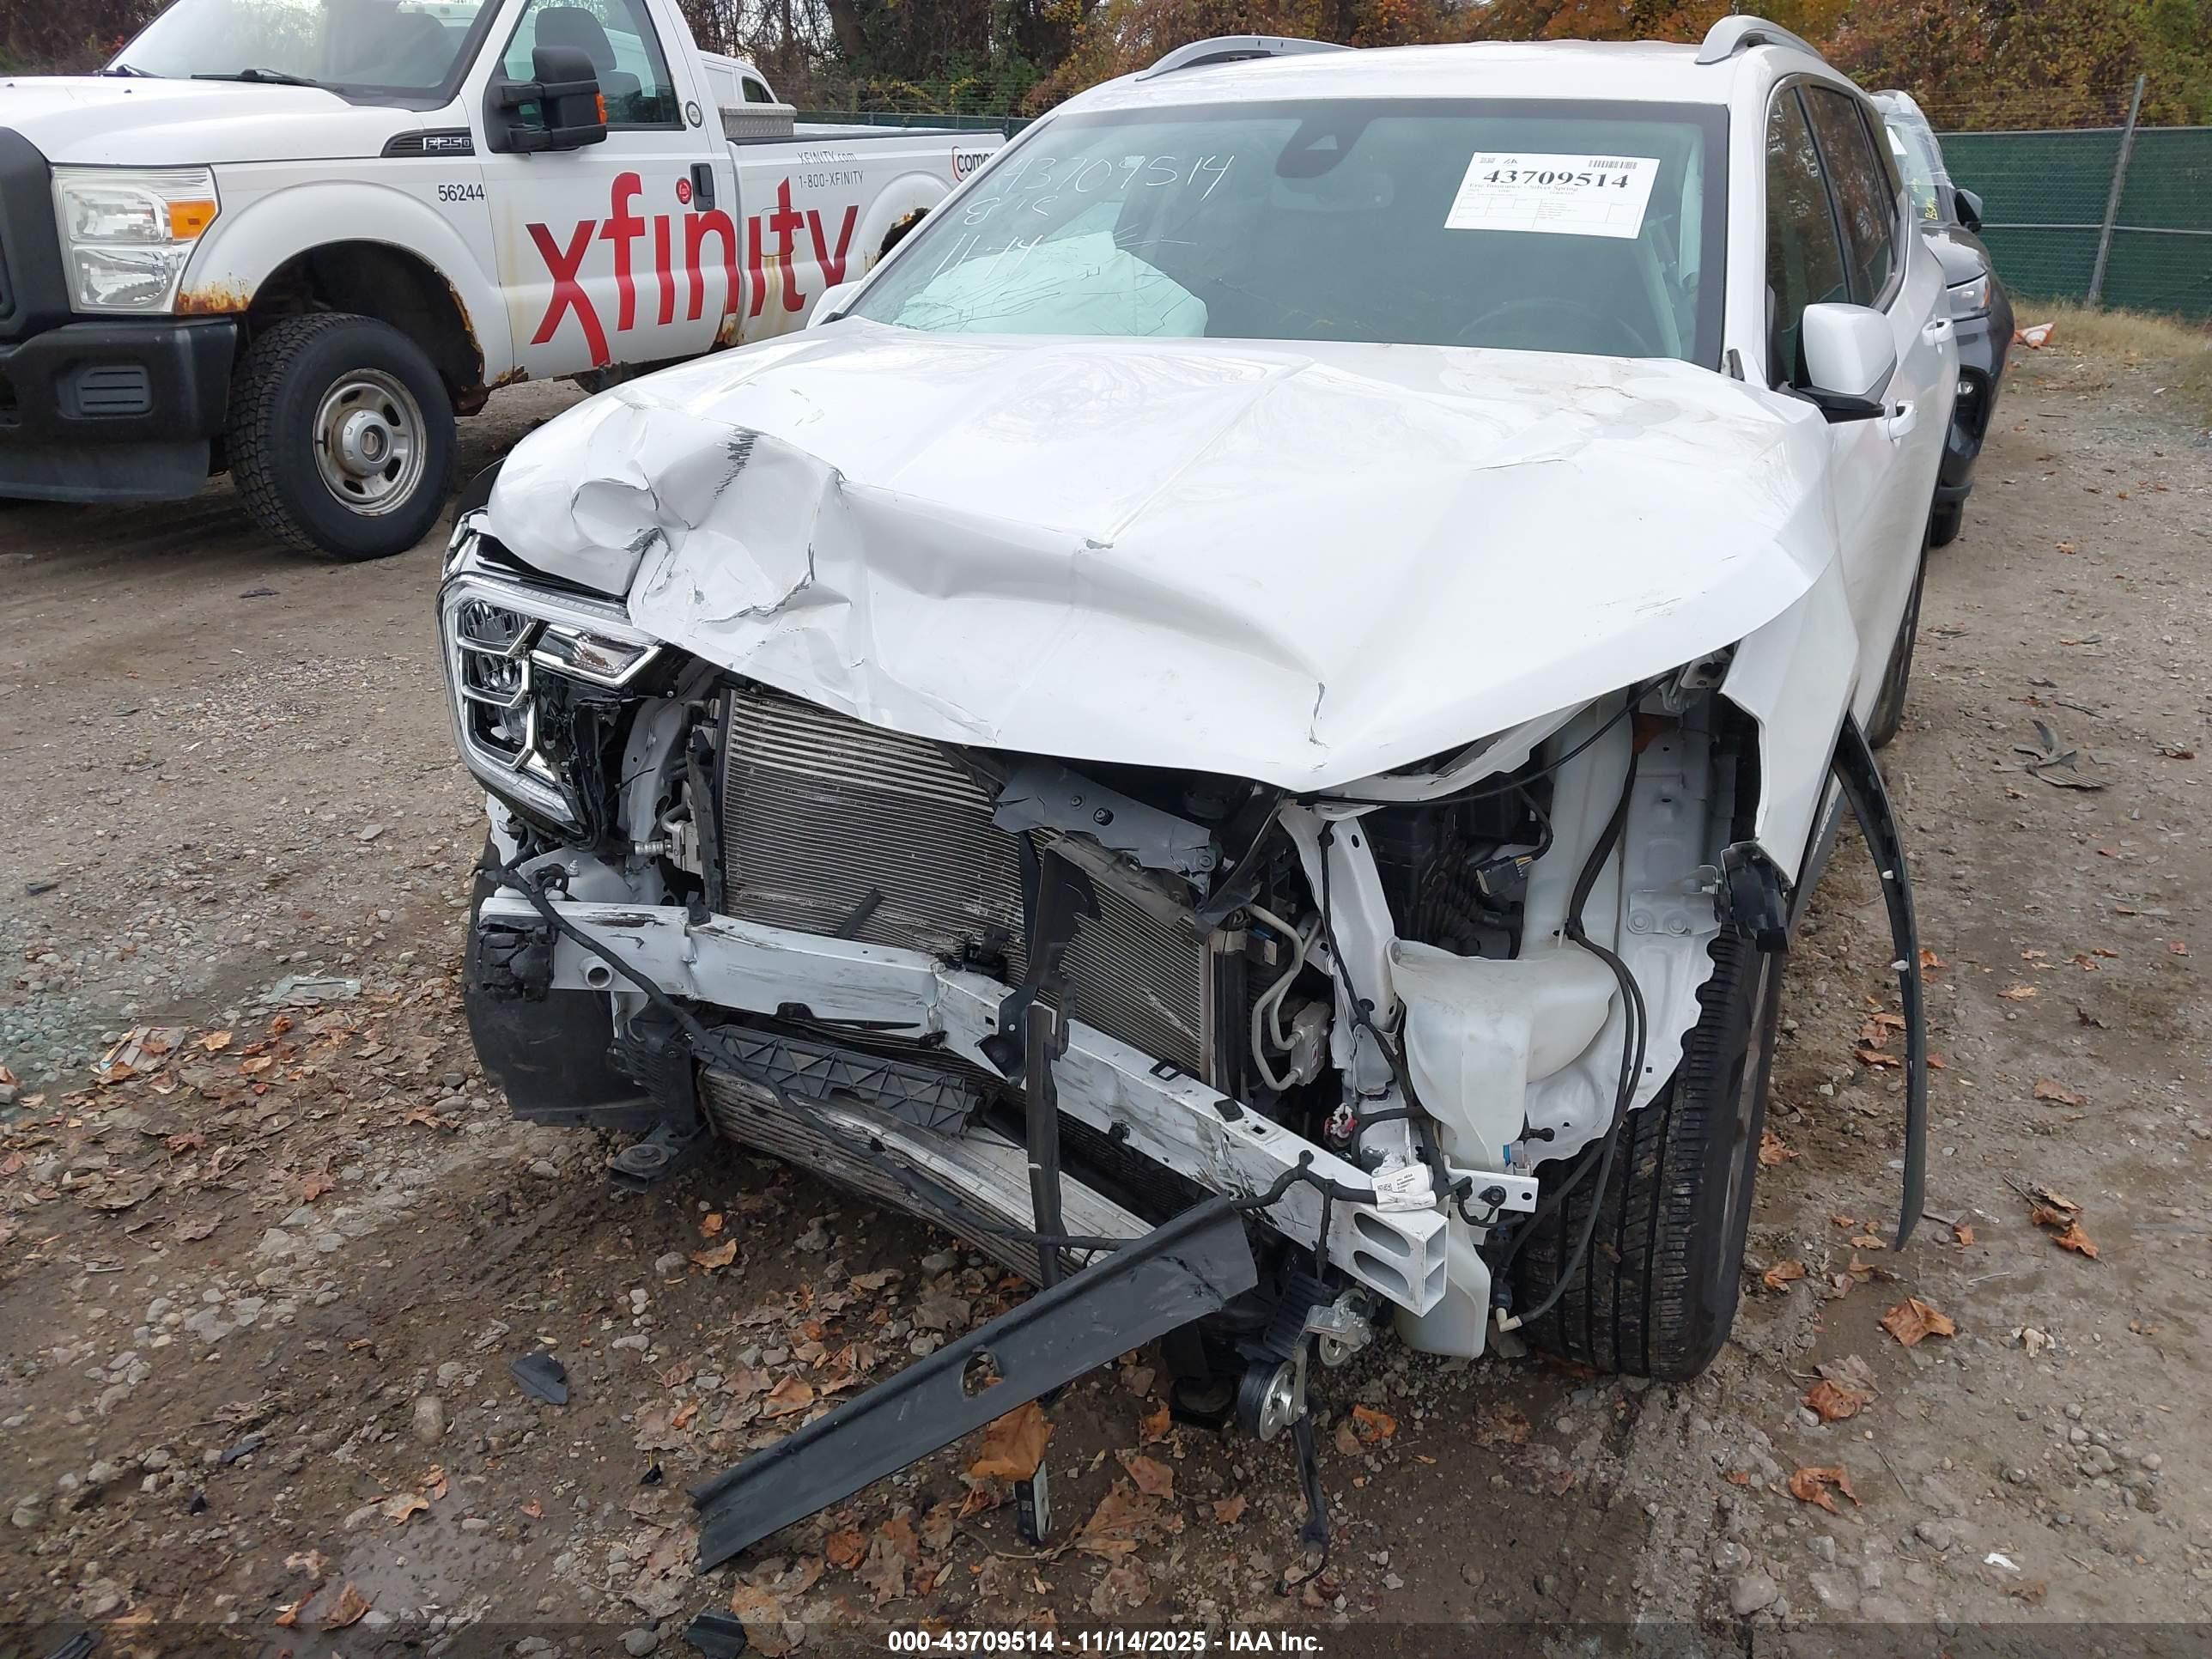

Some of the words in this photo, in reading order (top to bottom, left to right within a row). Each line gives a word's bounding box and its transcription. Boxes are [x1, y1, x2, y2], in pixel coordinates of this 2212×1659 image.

[422, 137, 473, 151] F-250
[797, 150, 858, 165] XFINITY.com
[957, 152, 995, 173] com
[799, 171, 864, 188] 1-800-XFINITY
[1003, 155, 1235, 202] 43709514
[1483, 169, 1629, 189] 43709514
[438, 183, 485, 202] 56244
[525, 171, 860, 368] xfinity
